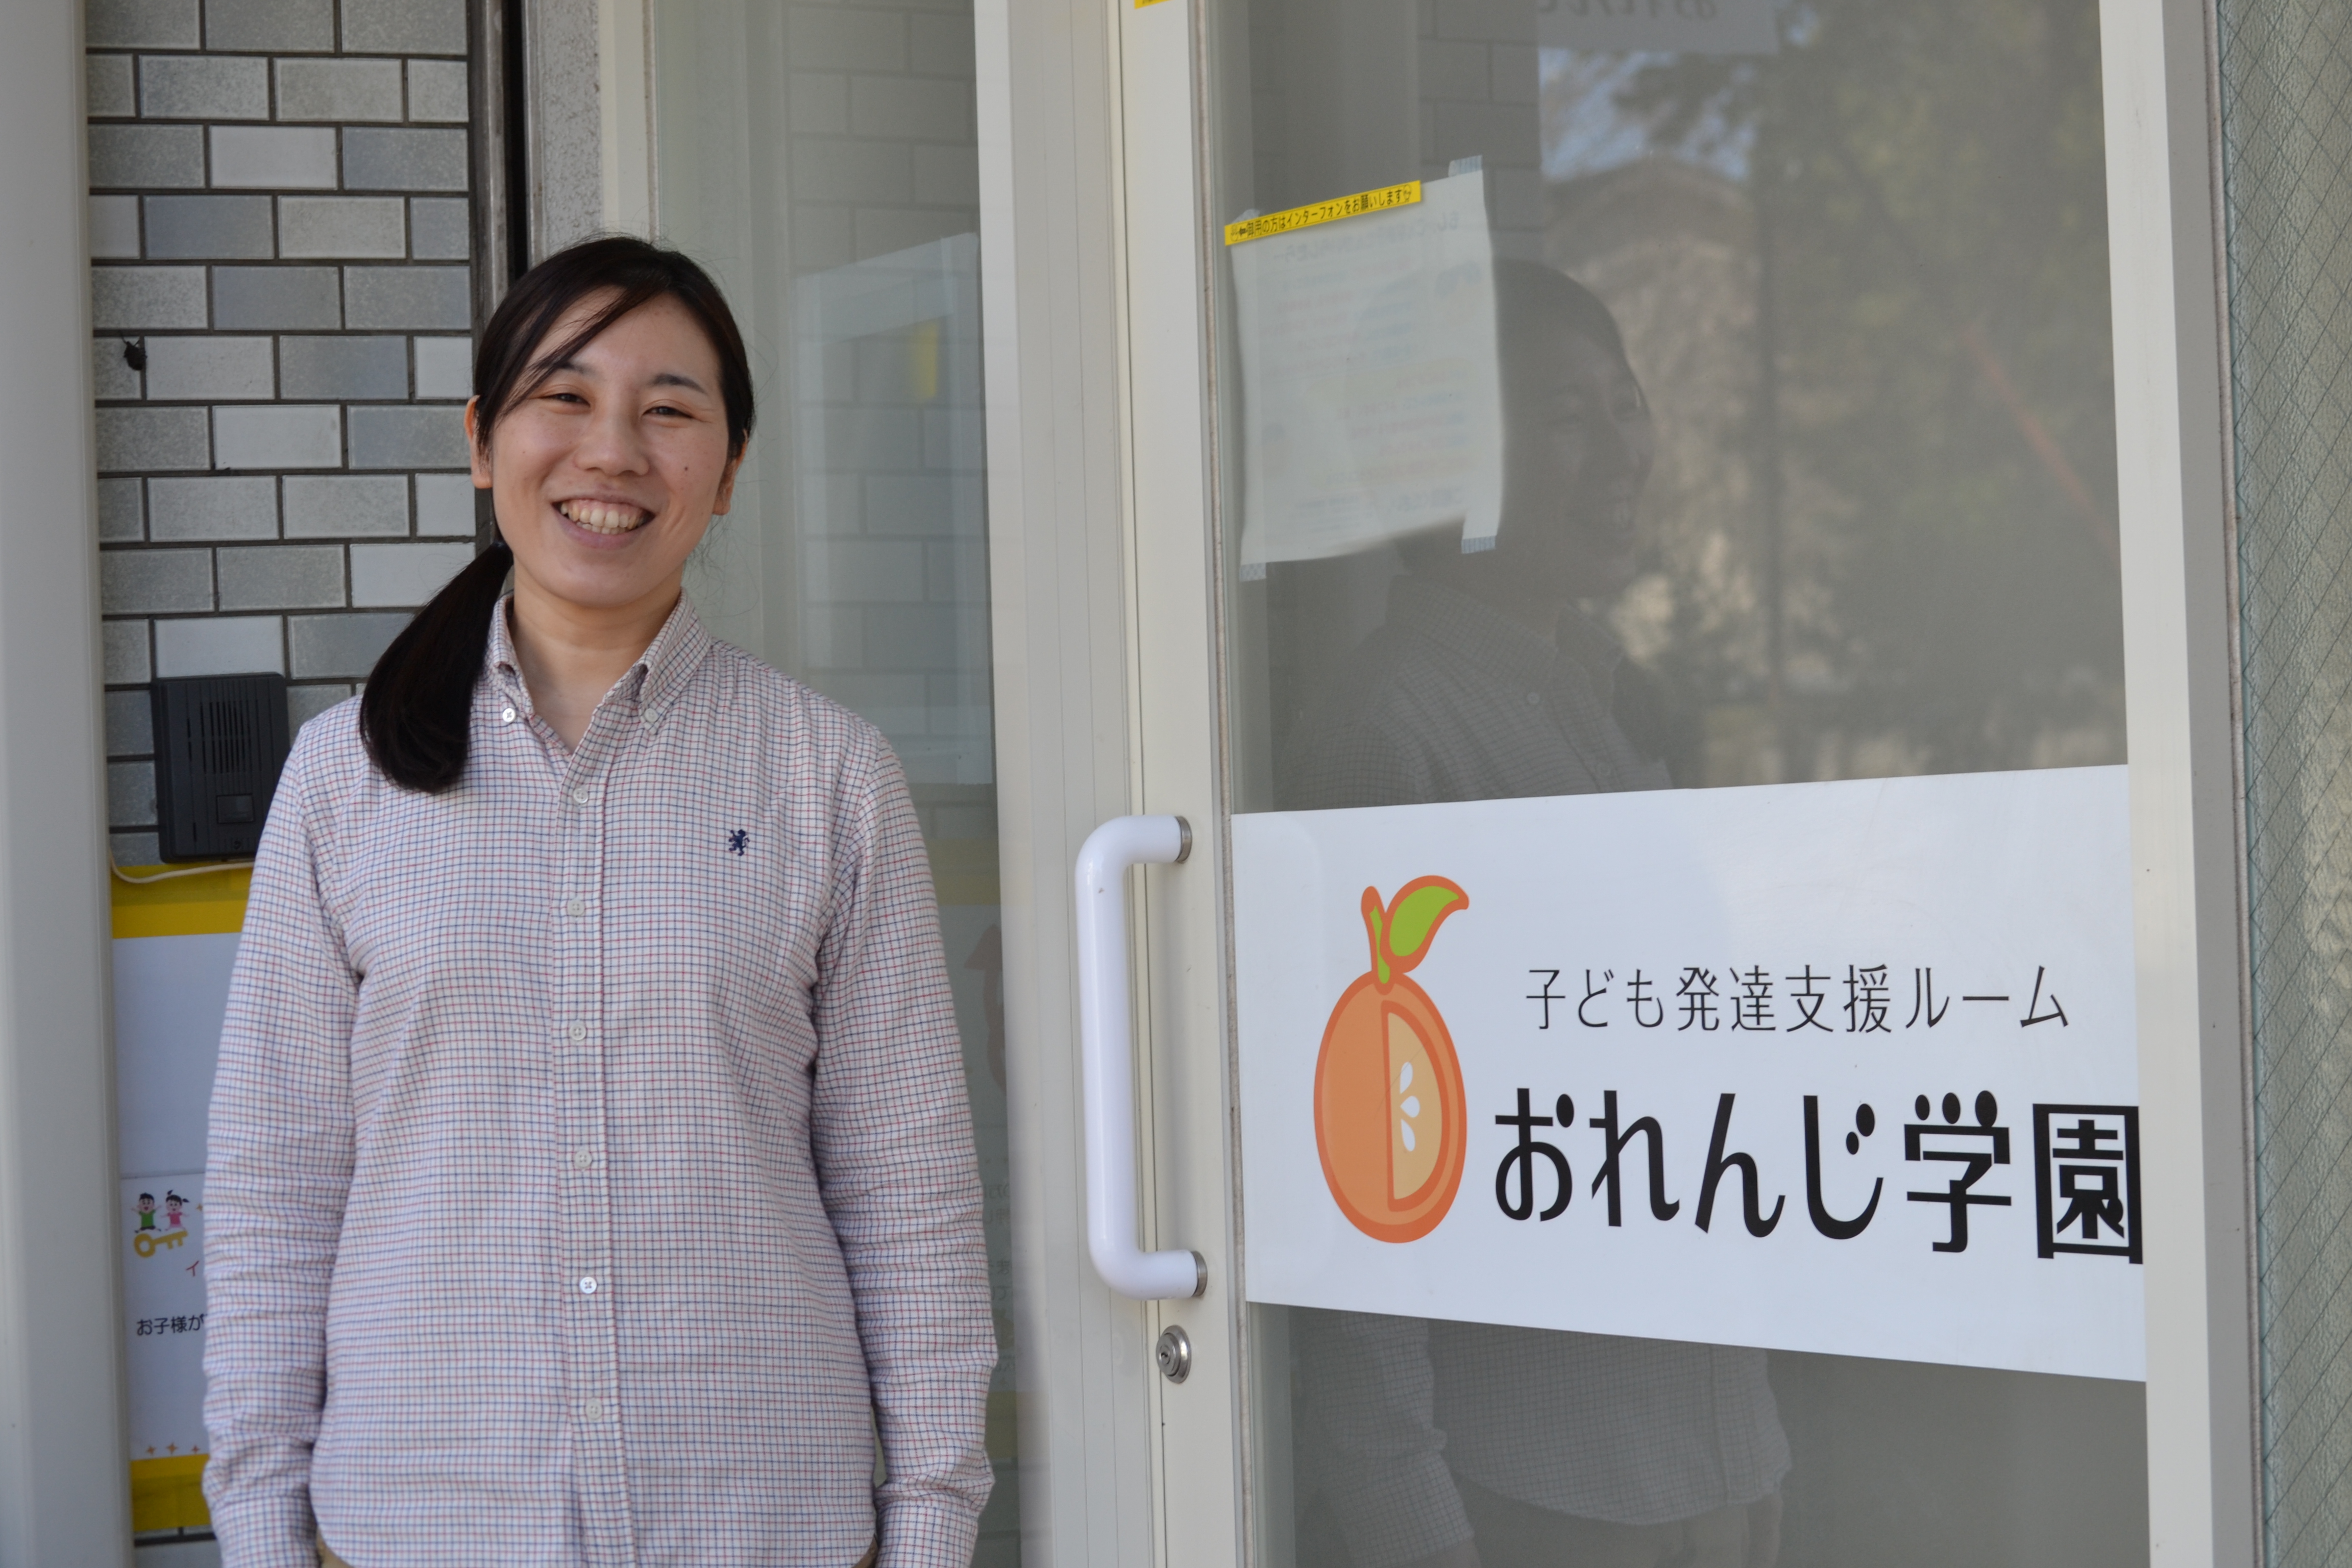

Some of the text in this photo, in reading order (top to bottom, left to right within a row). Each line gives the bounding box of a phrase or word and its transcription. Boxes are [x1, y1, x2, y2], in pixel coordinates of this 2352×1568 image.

[1526, 964, 2069, 1034] 子ども発達支援ルーム
[1495, 1088, 2143, 1264] おれんじ学園
